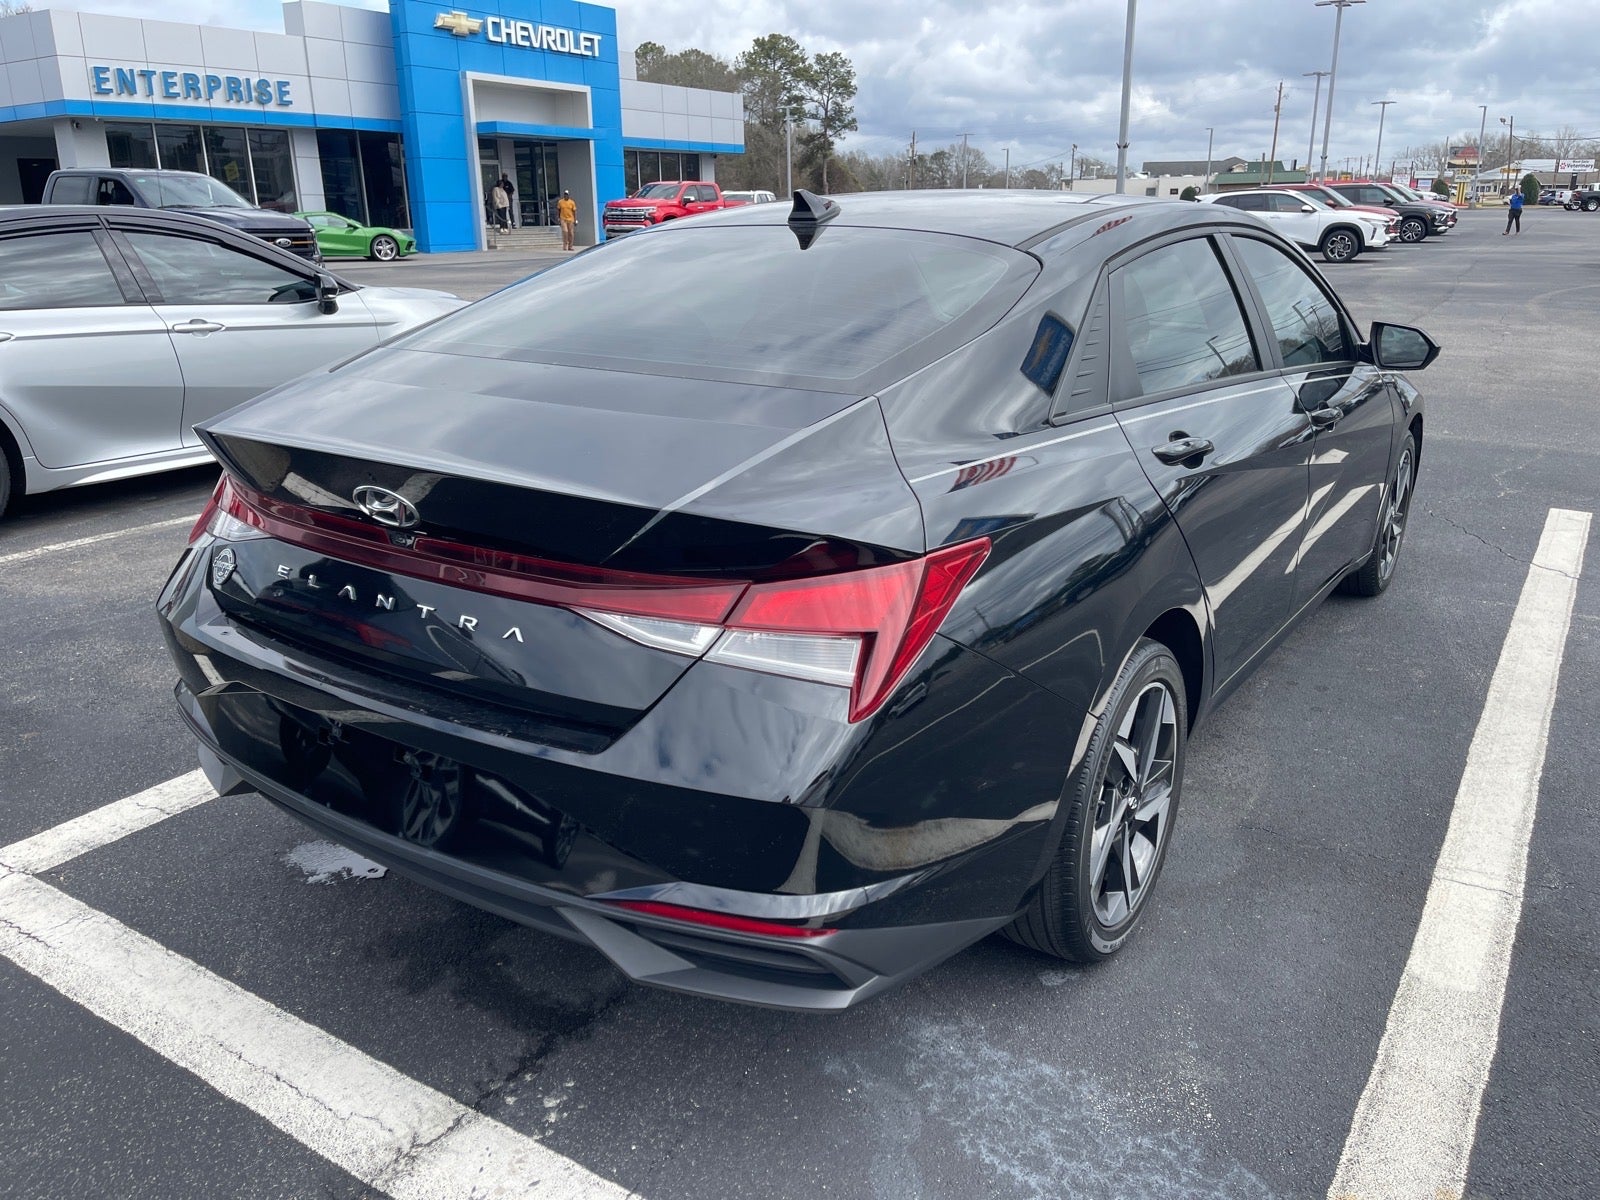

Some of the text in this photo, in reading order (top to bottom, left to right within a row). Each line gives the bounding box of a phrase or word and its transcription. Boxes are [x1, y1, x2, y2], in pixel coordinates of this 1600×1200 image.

[486, 16, 602, 57] CHEVROLET
[92, 66, 293, 106] ENTERPRISE
[277, 564, 525, 643] ELANTRA
